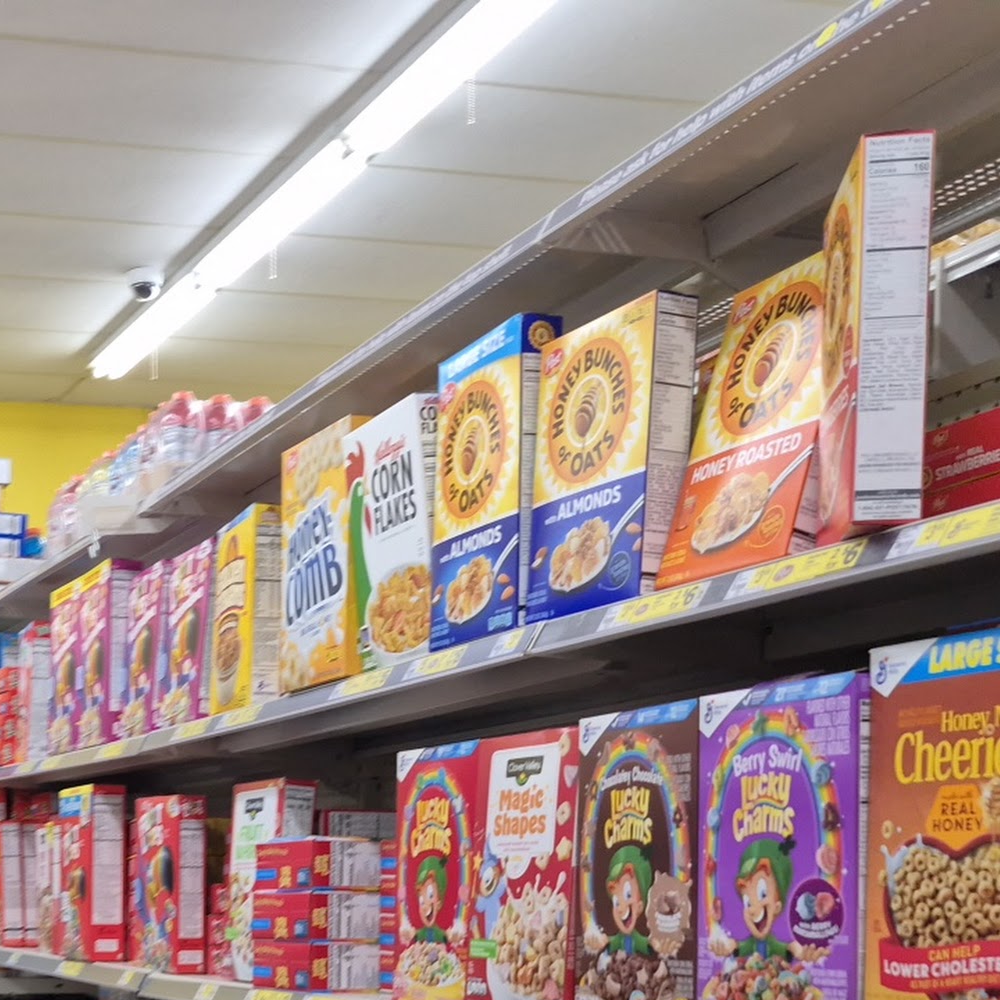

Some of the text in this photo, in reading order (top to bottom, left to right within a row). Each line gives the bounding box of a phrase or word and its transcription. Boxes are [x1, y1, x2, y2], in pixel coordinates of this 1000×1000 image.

[727, 305, 774, 391] HONEY
[552, 347, 626, 439] HONEY BUNCHES
[739, 378, 794, 429] OATS
[570, 430, 615, 477] OATS
[690, 432, 803, 485] HONEY ROASTED
[934, 449, 1000, 481] STRAWBERRIE
[371, 450, 414, 503] CORN
[459, 469, 494, 513] OATS
[374, 489, 418, 537] FLAKES
[557, 484, 622, 521] ALMONDS
[450, 525, 502, 557] ALMONDS
[928, 636, 995, 675] LARGE
[941, 710, 991, 736] Honey
[732, 744, 804, 777] Berry Swirl
[895, 729, 1000, 785] Cheeri
[499, 785, 545, 813] Magic
[610, 786, 651, 822] Lucky
[741, 771, 792, 811] Lucky
[942, 802, 977, 816] REAL
[493, 814, 547, 840] Shapes
[604, 815, 653, 850] Charms
[733, 804, 795, 843] Charms
[932, 818, 984, 833] HONEY
[883, 956, 1000, 979] LOWER CHOLESTE
[928, 945, 981, 963] CAN HELP
